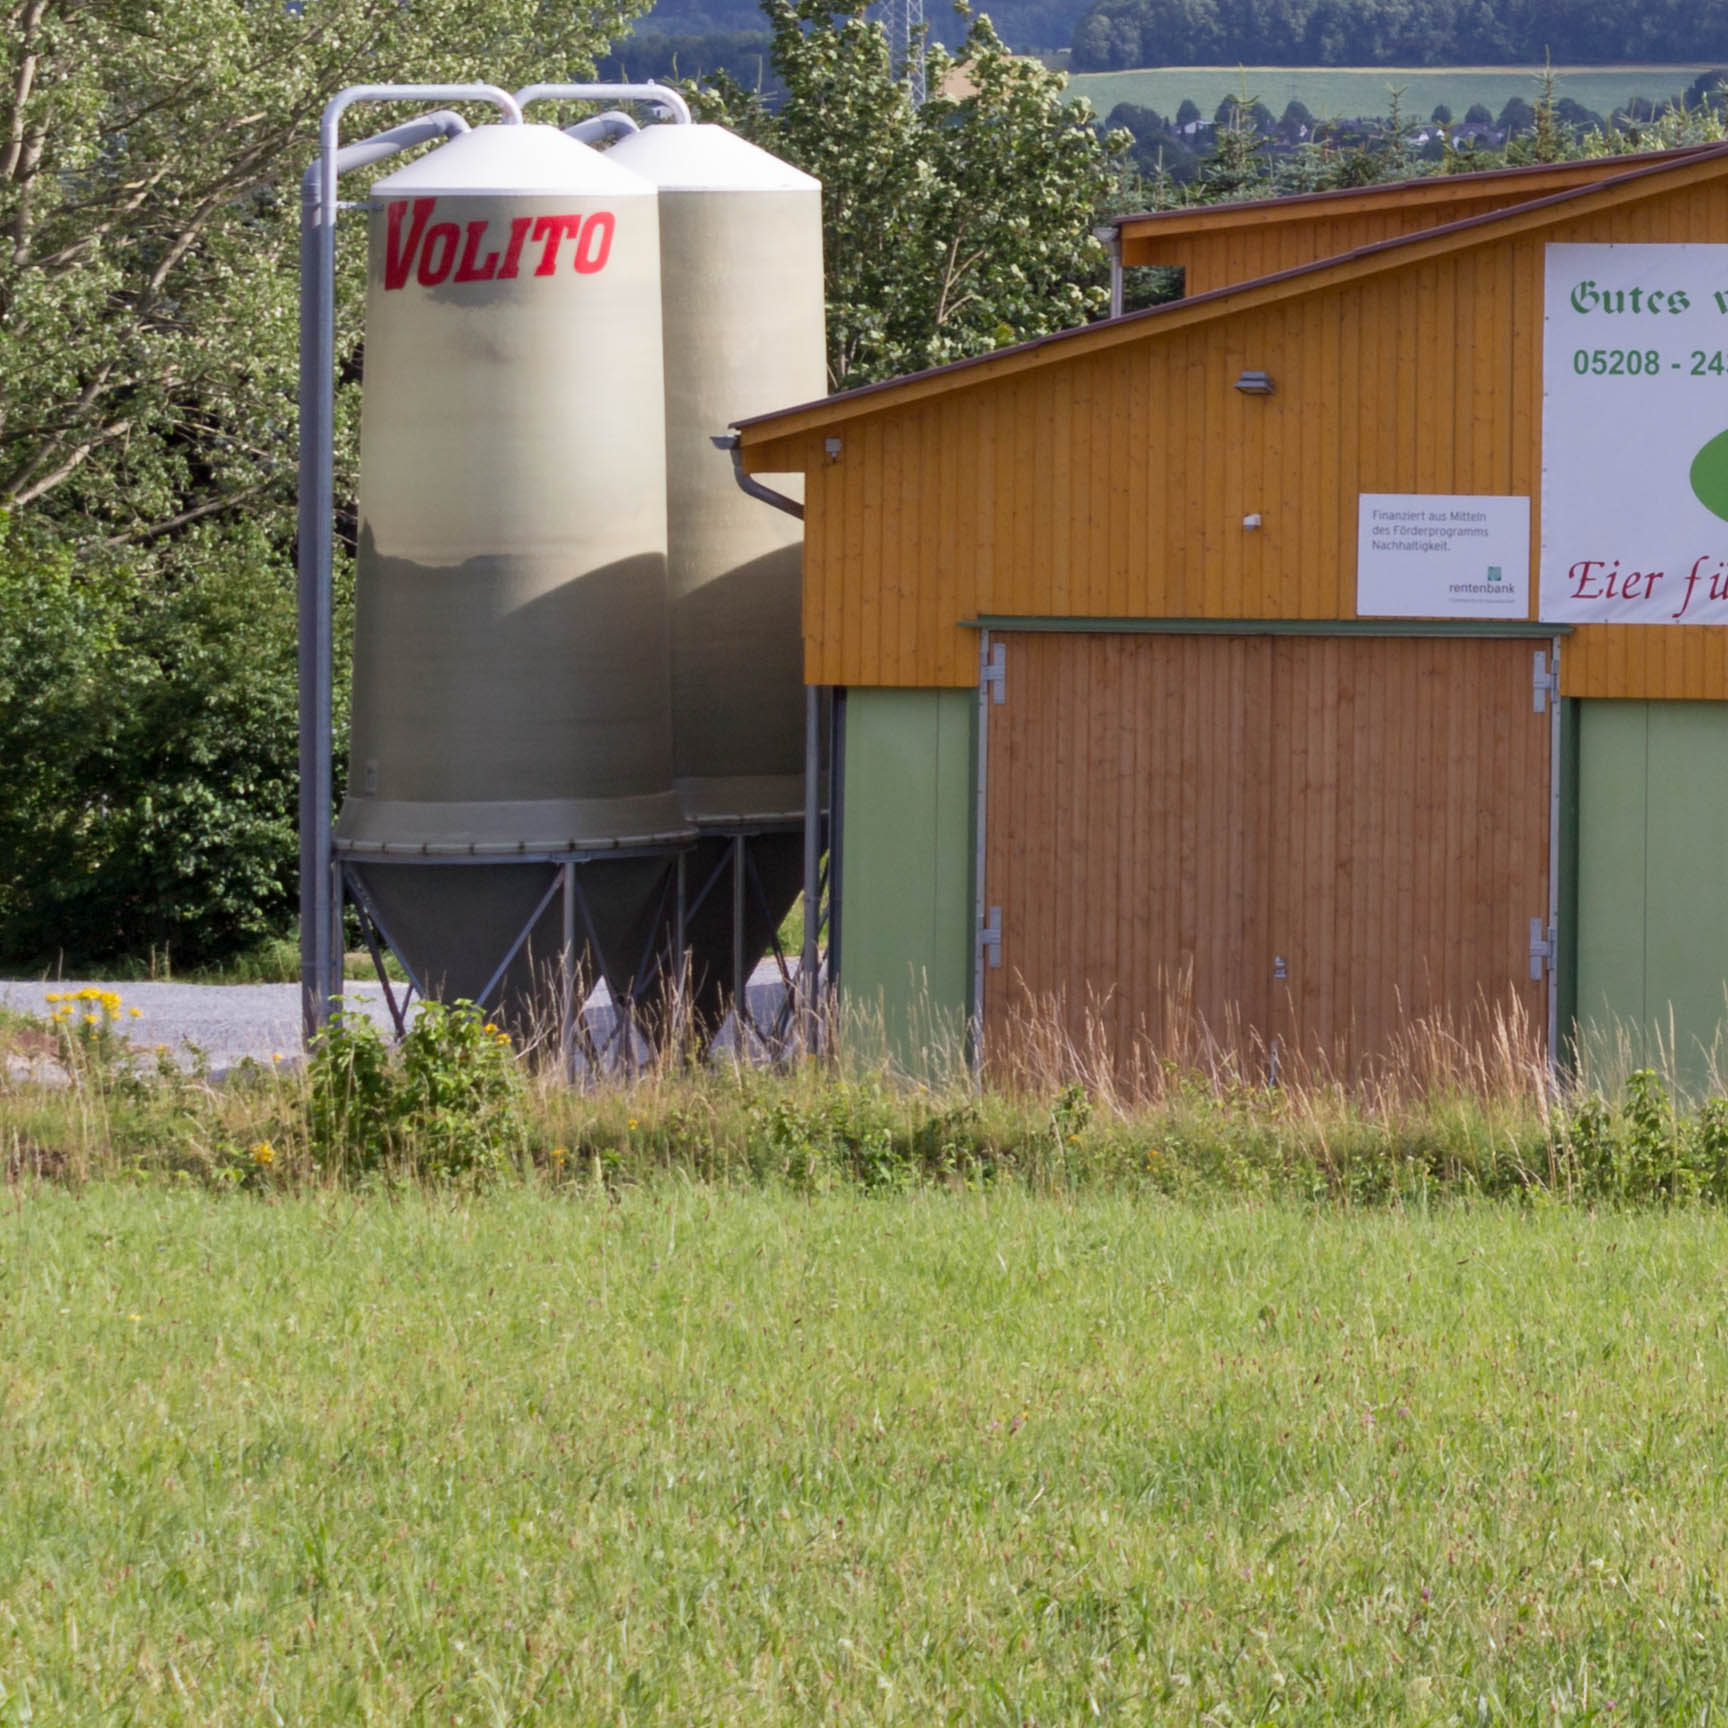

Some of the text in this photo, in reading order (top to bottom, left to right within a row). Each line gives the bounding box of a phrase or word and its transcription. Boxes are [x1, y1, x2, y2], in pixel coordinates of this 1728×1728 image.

[385, 197, 615, 290] VOLITO
[1570, 280, 1691, 315] Gutes
[1573, 350, 1661, 376] 05208
[1372, 510, 1487, 521] Finanziert aus Mitteln
[1372, 524, 1489, 538] des Förderprogramms
[1372, 540, 1451, 552] Nachhaltigkeit.
[1449, 583, 1515, 593] rentenbank
[1568, 560, 1663, 600] Eier
